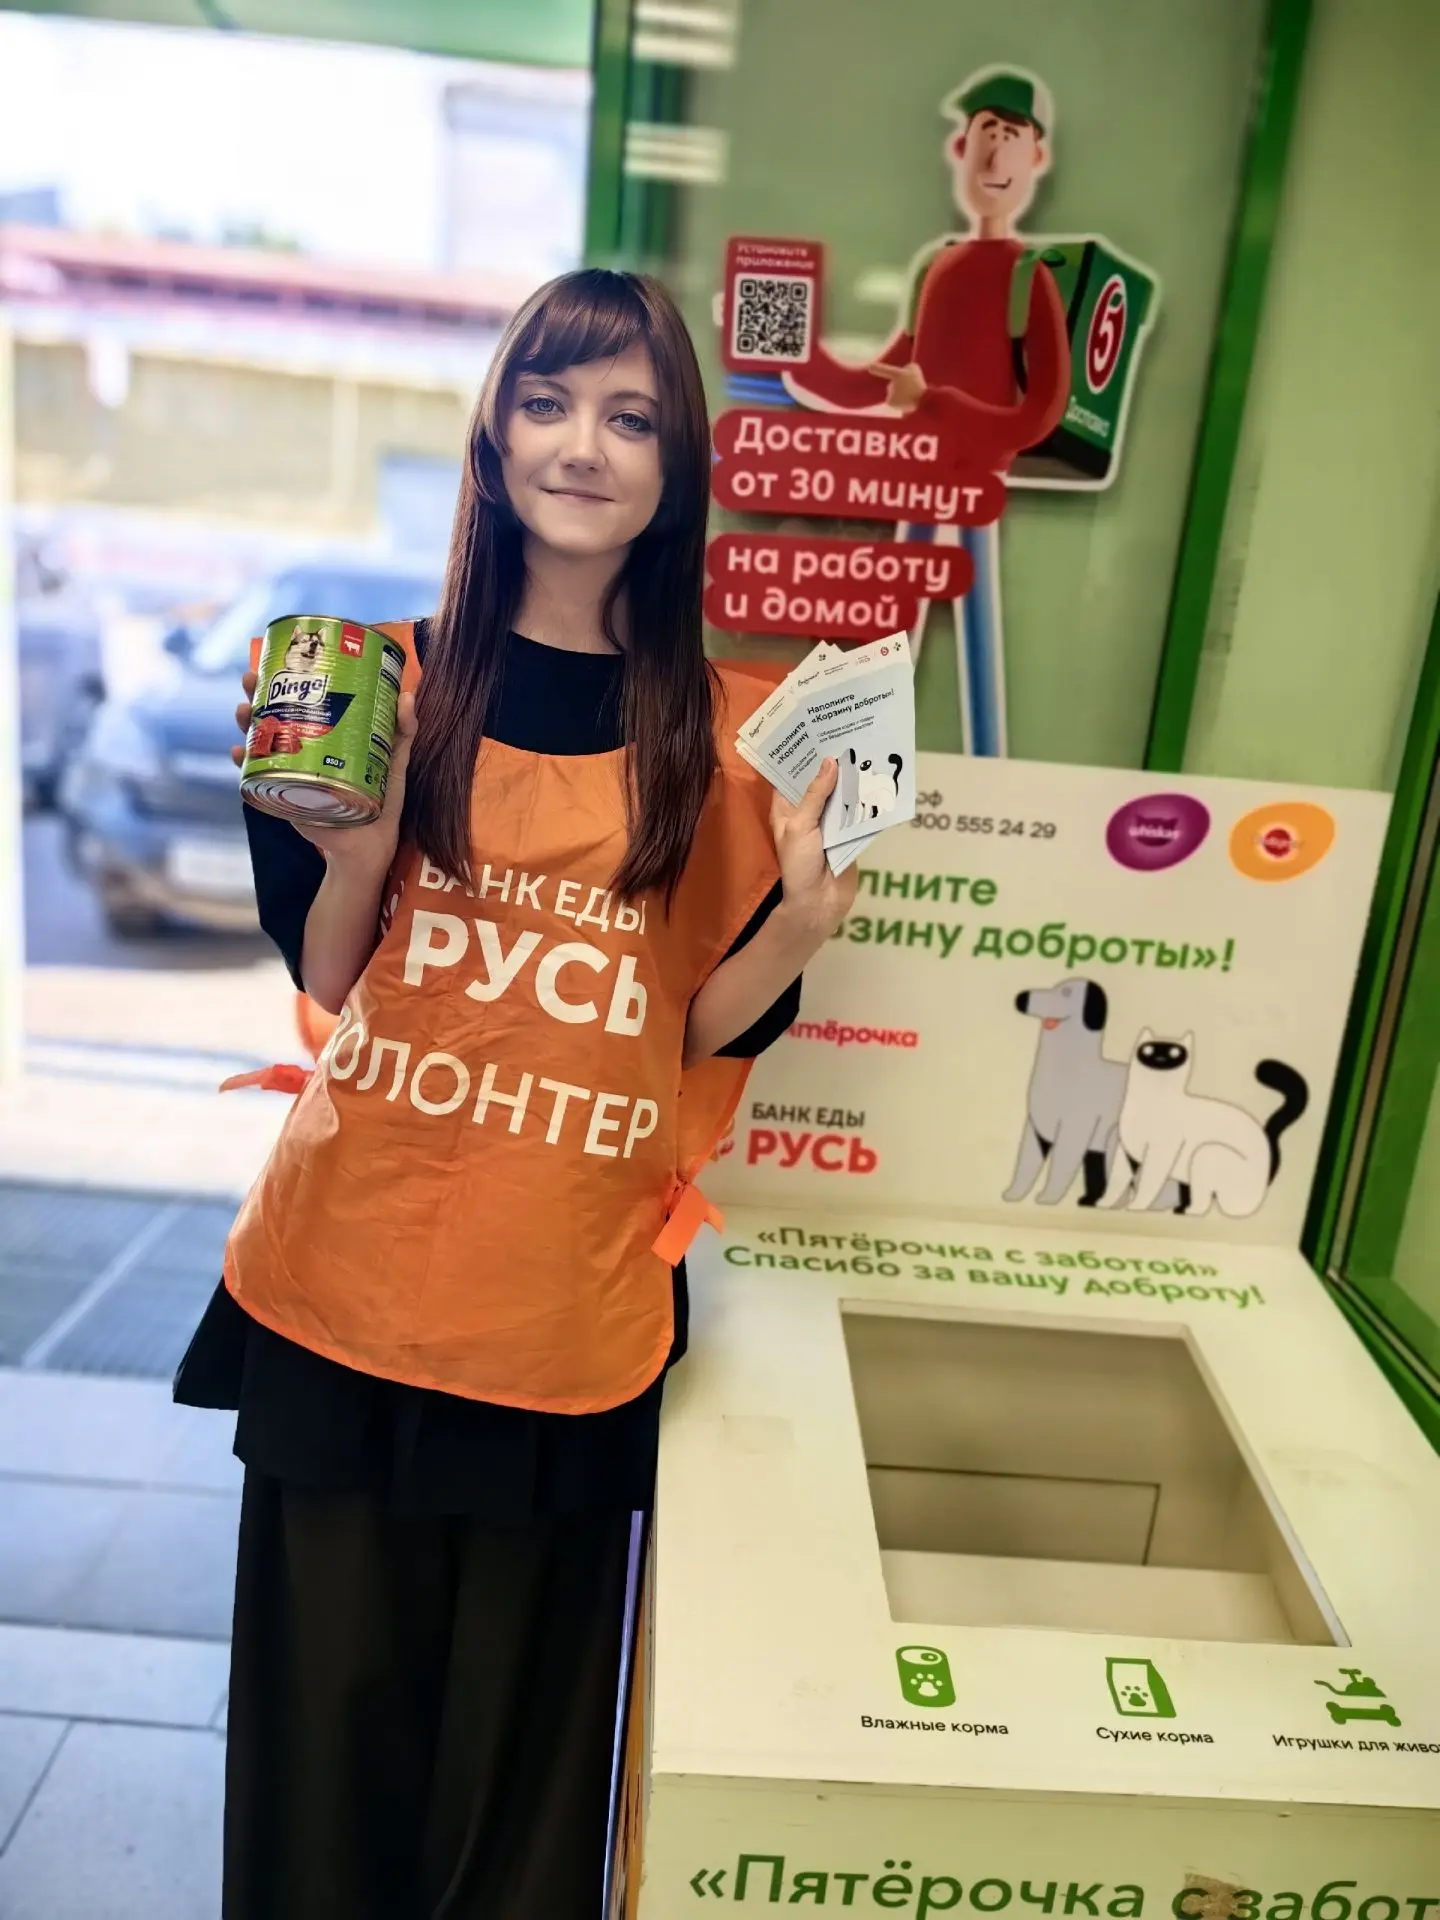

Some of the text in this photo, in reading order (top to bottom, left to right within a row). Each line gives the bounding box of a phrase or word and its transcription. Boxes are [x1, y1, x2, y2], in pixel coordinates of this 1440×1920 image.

[733, 417, 939, 462] Доставка
[731, 469, 983, 519] от 30 минут
[727, 546, 950, 592] на работу
[724, 591, 899, 629] и домой
[270, 677, 323, 701] Dingo
[807, 694, 855, 714] Наполните
[811, 705, 852, 724] «Корзину
[854, 688, 894, 711] доброты»!
[768, 720, 806, 759] Наполните
[777, 731, 809, 765] «Корзину
[325, 757, 339, 766] 850
[956, 815, 994, 835] 555
[998, 820, 1024, 837] 24
[1030, 822, 1056, 839] 29
[858, 869, 998, 906] лните
[554, 879, 647, 935] ЕДЫ
[831, 916, 1235, 973] зину доброты»!
[403, 909, 647, 1037] РУСЬ
[786, 1018, 918, 1047] тёрочка
[751, 1101, 866, 1128] БАНК ЕДЫ
[746, 1128, 878, 1174] РУСЬ
[756, 1227, 1219, 1278] «Пятёрочка с заботой»
[722, 1245, 1267, 1310] Спасибо за вашу доброту!
[860, 1714, 1010, 1736] Влажные корма
[1095, 1726, 1215, 1745] Сухие корма
[1272, 1733, 1440, 1753] Игрушки для живо
[689, 1852, 1145, 1920] «Пятёрочка
[1228, 1880, 1440, 1920] забот
